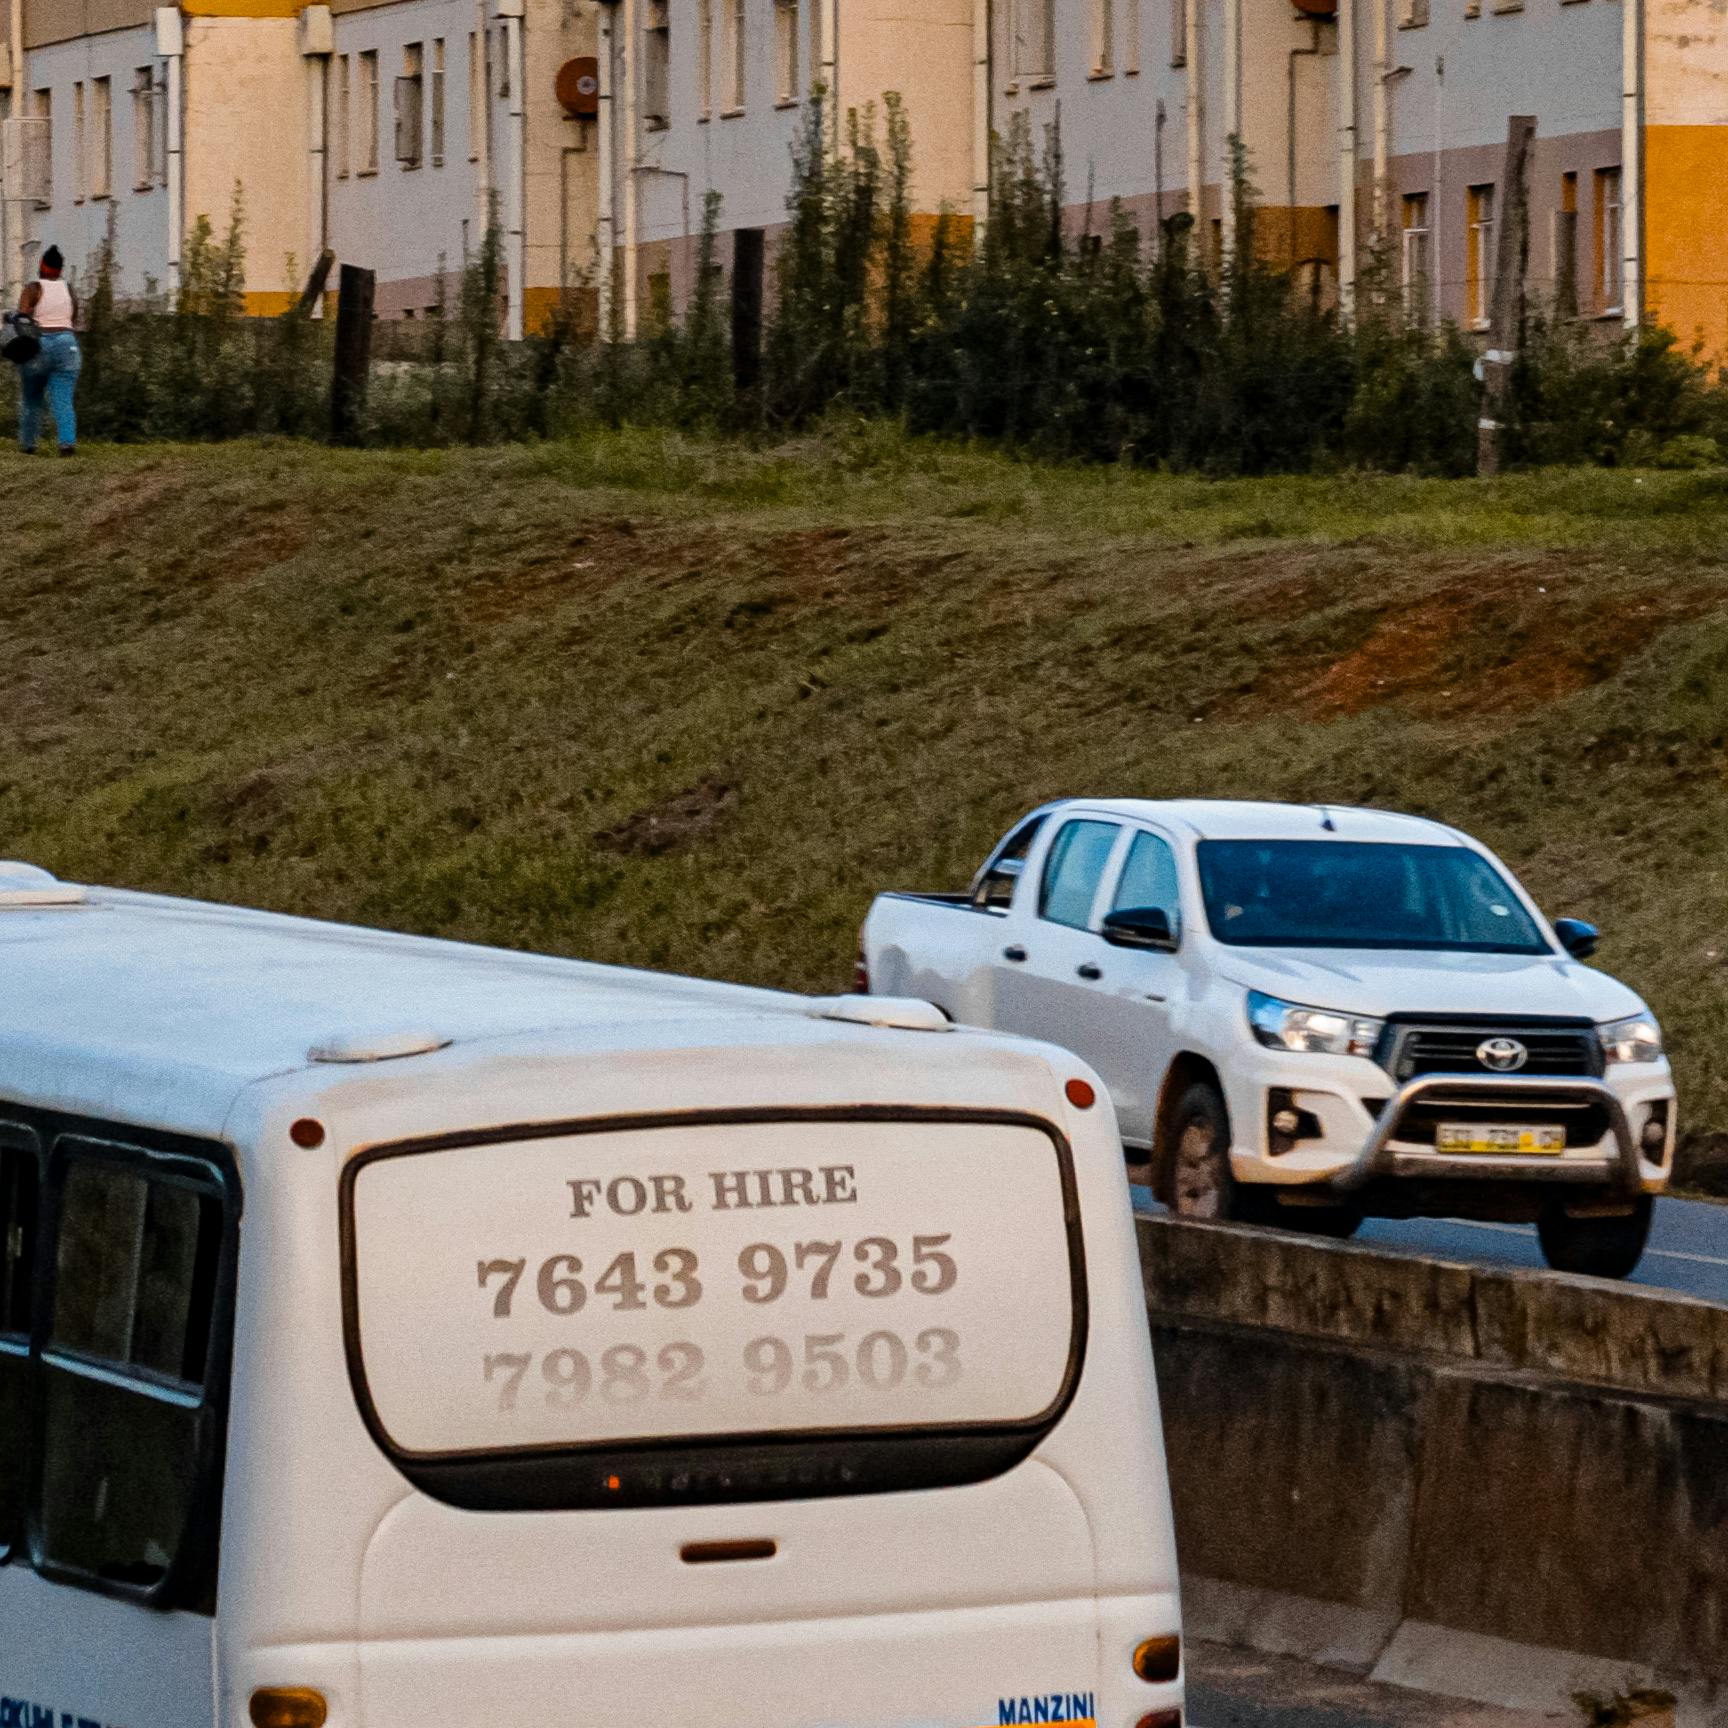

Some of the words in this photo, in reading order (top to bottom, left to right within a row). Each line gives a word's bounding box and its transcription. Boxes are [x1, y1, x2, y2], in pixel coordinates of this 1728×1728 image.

[567, 1174, 692, 1218] FOR
[708, 1165, 858, 1210] HIRE
[477, 1247, 703, 1318] 7643
[737, 1233, 958, 1304] 9735
[483, 1341, 708, 1413] 7982
[743, 1327, 963, 1399] 9503
[998, 1691, 1094, 1726] MANZINI
